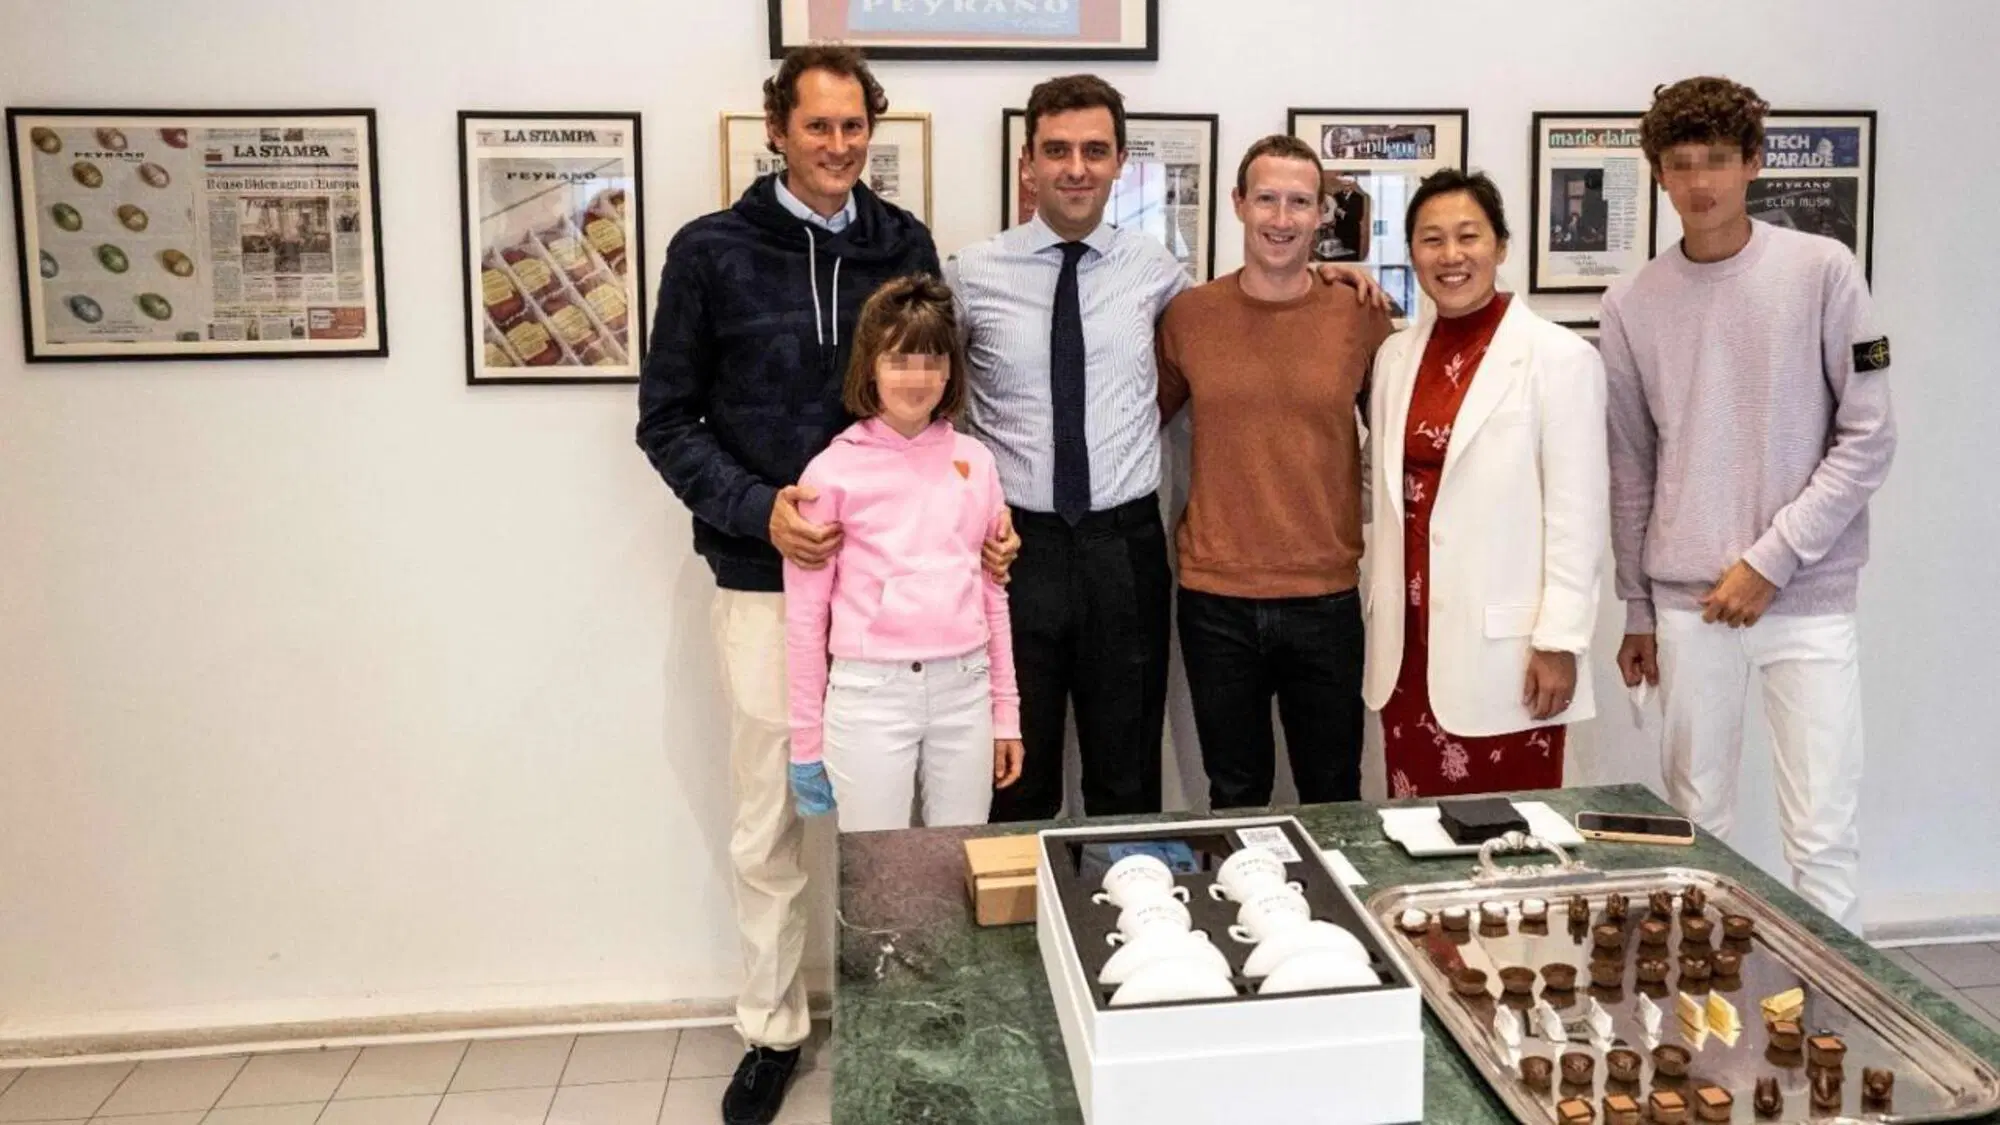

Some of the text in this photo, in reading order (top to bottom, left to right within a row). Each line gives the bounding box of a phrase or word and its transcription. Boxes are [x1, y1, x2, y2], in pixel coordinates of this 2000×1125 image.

[504, 130, 529, 143] LA
[530, 130, 597, 143] STAMPA
[1551, 129, 1641, 145] marie claire
[1766, 135, 1810, 149] TECH
[233, 145, 258, 158] LA
[259, 145, 329, 158] STAMPA
[1766, 152, 1834, 167] PARADE
[506, 172, 597, 180] PEYRANO
